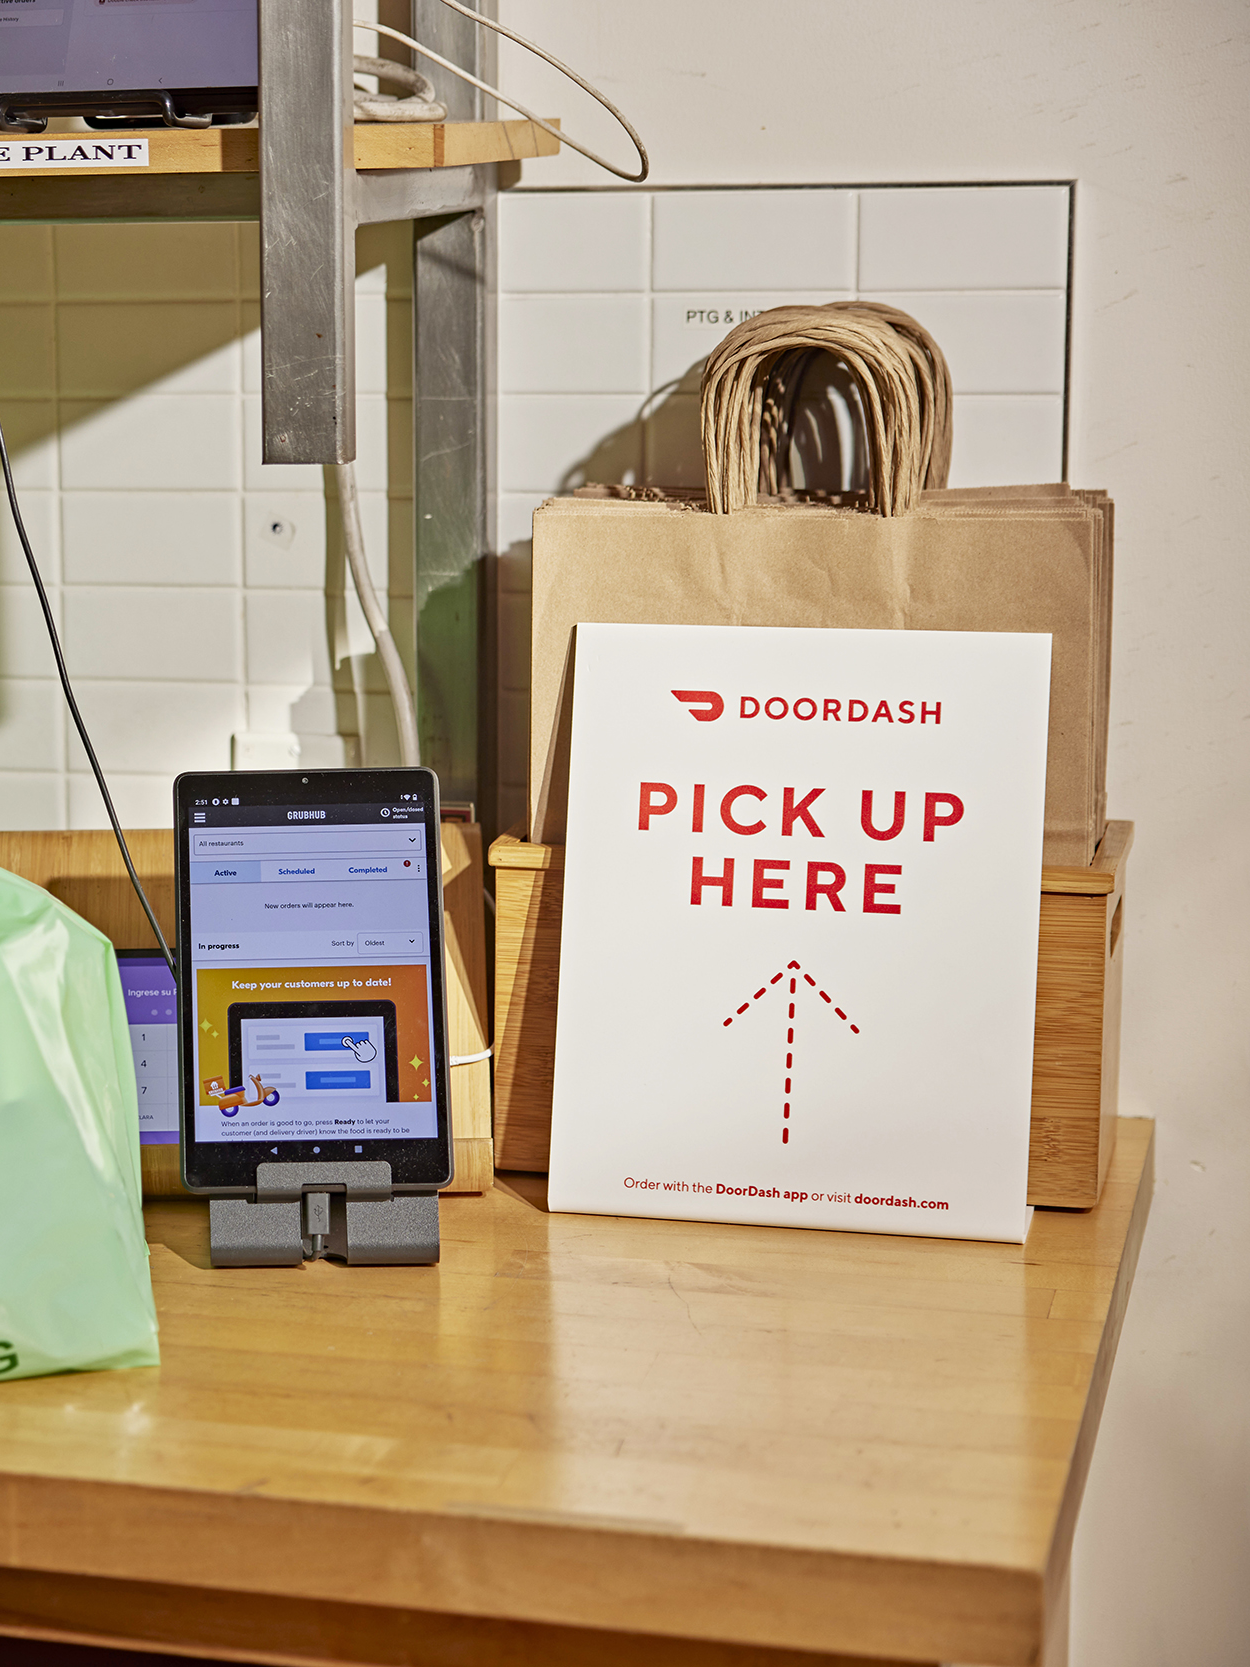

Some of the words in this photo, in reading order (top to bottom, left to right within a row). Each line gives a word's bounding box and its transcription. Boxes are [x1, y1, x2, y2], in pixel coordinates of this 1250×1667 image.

[21, 144, 142, 162] PLANT
[686, 309, 719, 324] PTG
[724, 309, 734, 324] &
[739, 696, 942, 725] DOORDASH
[287, 810, 326, 820] GRUBHUB
[638, 782, 826, 838] PICK
[861, 789, 965, 843] UP
[349, 867, 387, 875] Completed
[690, 856, 902, 915] HERE
[208, 943, 240, 951] progress
[232, 981, 257, 990] Keep
[260, 982, 282, 990] your
[284, 980, 335, 989] customers
[337, 981, 350, 990] up
[352, 979, 363, 987] to
[364, 978, 392, 987] date!
[128, 989, 159, 997] Ingrese
[269, 1128, 295, 1136] delivery
[296, 1128, 318, 1136] driver)
[624, 1177, 660, 1191] Order
[663, 1180, 688, 1193] with
[692, 1182, 712, 1194] the
[716, 1183, 780, 1199] DoorDash
[783, 1190, 808, 1202] app
[811, 1192, 823, 1202] or
[826, 1191, 852, 1204] visit
[854, 1193, 949, 1210] doordash.com
